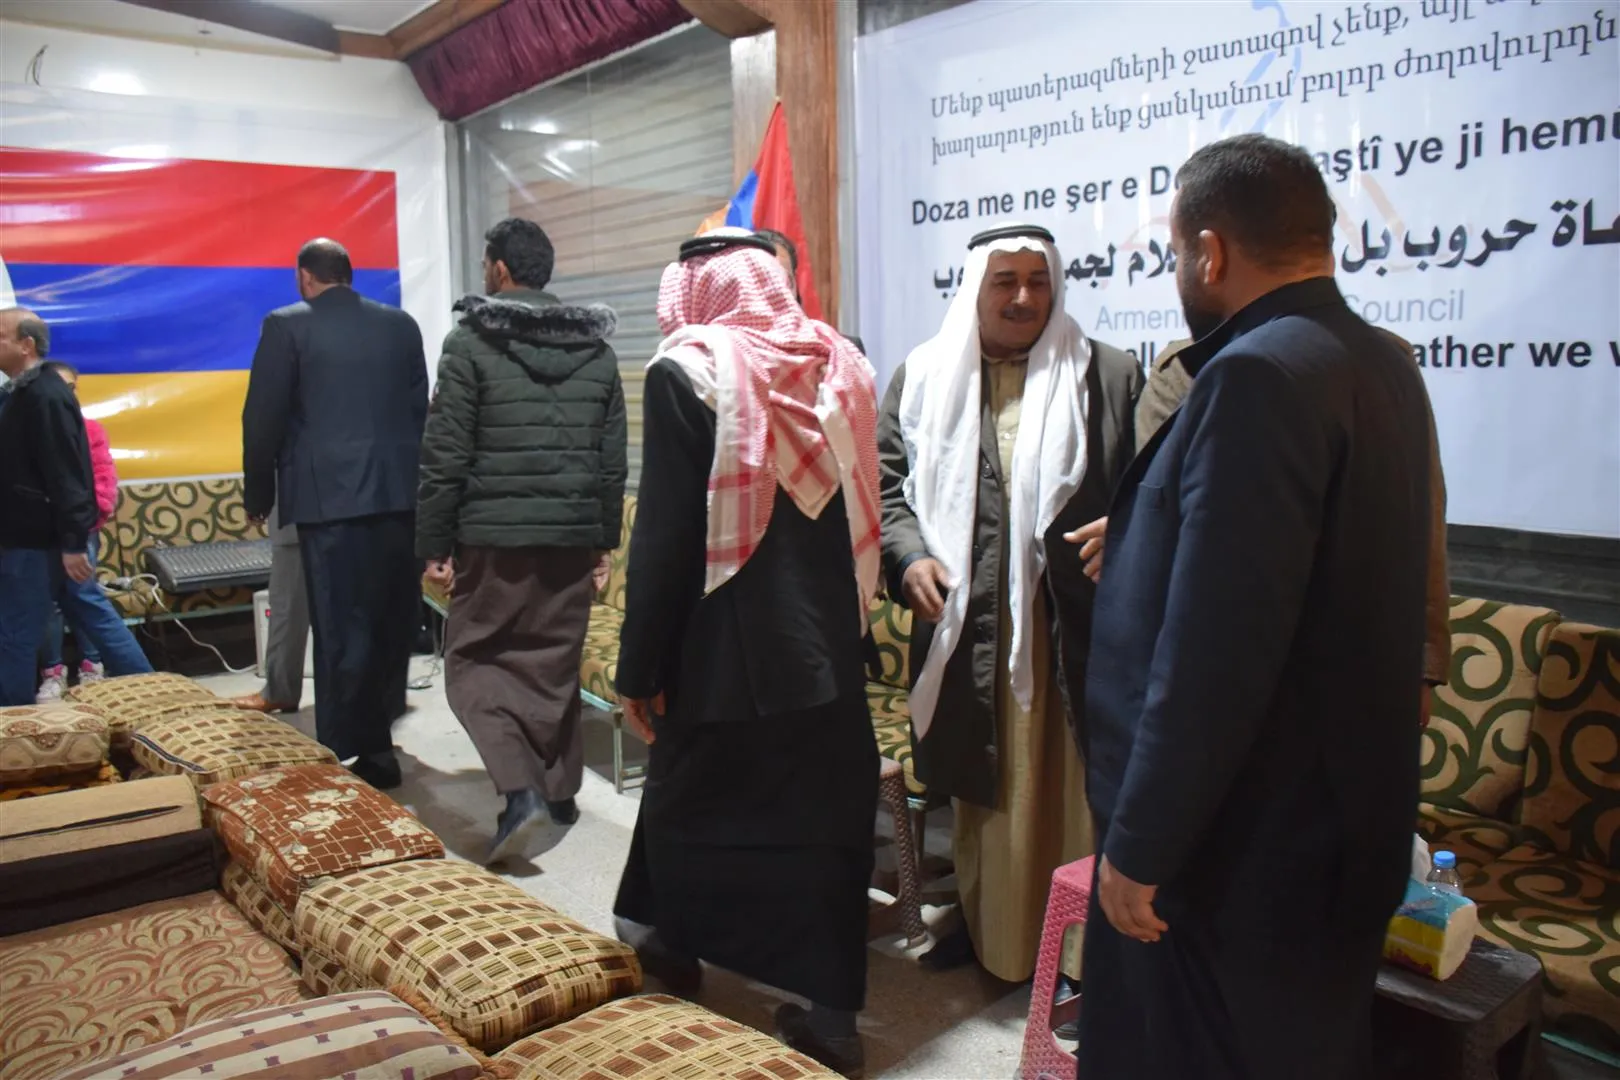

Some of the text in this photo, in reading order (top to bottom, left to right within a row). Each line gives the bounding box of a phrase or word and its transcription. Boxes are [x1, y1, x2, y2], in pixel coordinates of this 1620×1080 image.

[931, 93, 983, 118] Մենք
[1091, 105, 1132, 132] ենք
[1137, 70, 1294, 130] ցանկանում
[1301, 62, 1385, 103] բոլոր
[1395, 137, 1444, 177] ye
[1455, 121, 1484, 170] ji
[912, 199, 970, 226] Doza
[977, 192, 1015, 217] me
[1023, 187, 1057, 211] ne
[1065, 179, 1113, 213] şer
[1121, 176, 1139, 199] e
[1341, 219, 1392, 277] بل
[1403, 218, 1538, 272] حروب
[1527, 340, 1593, 368] we
